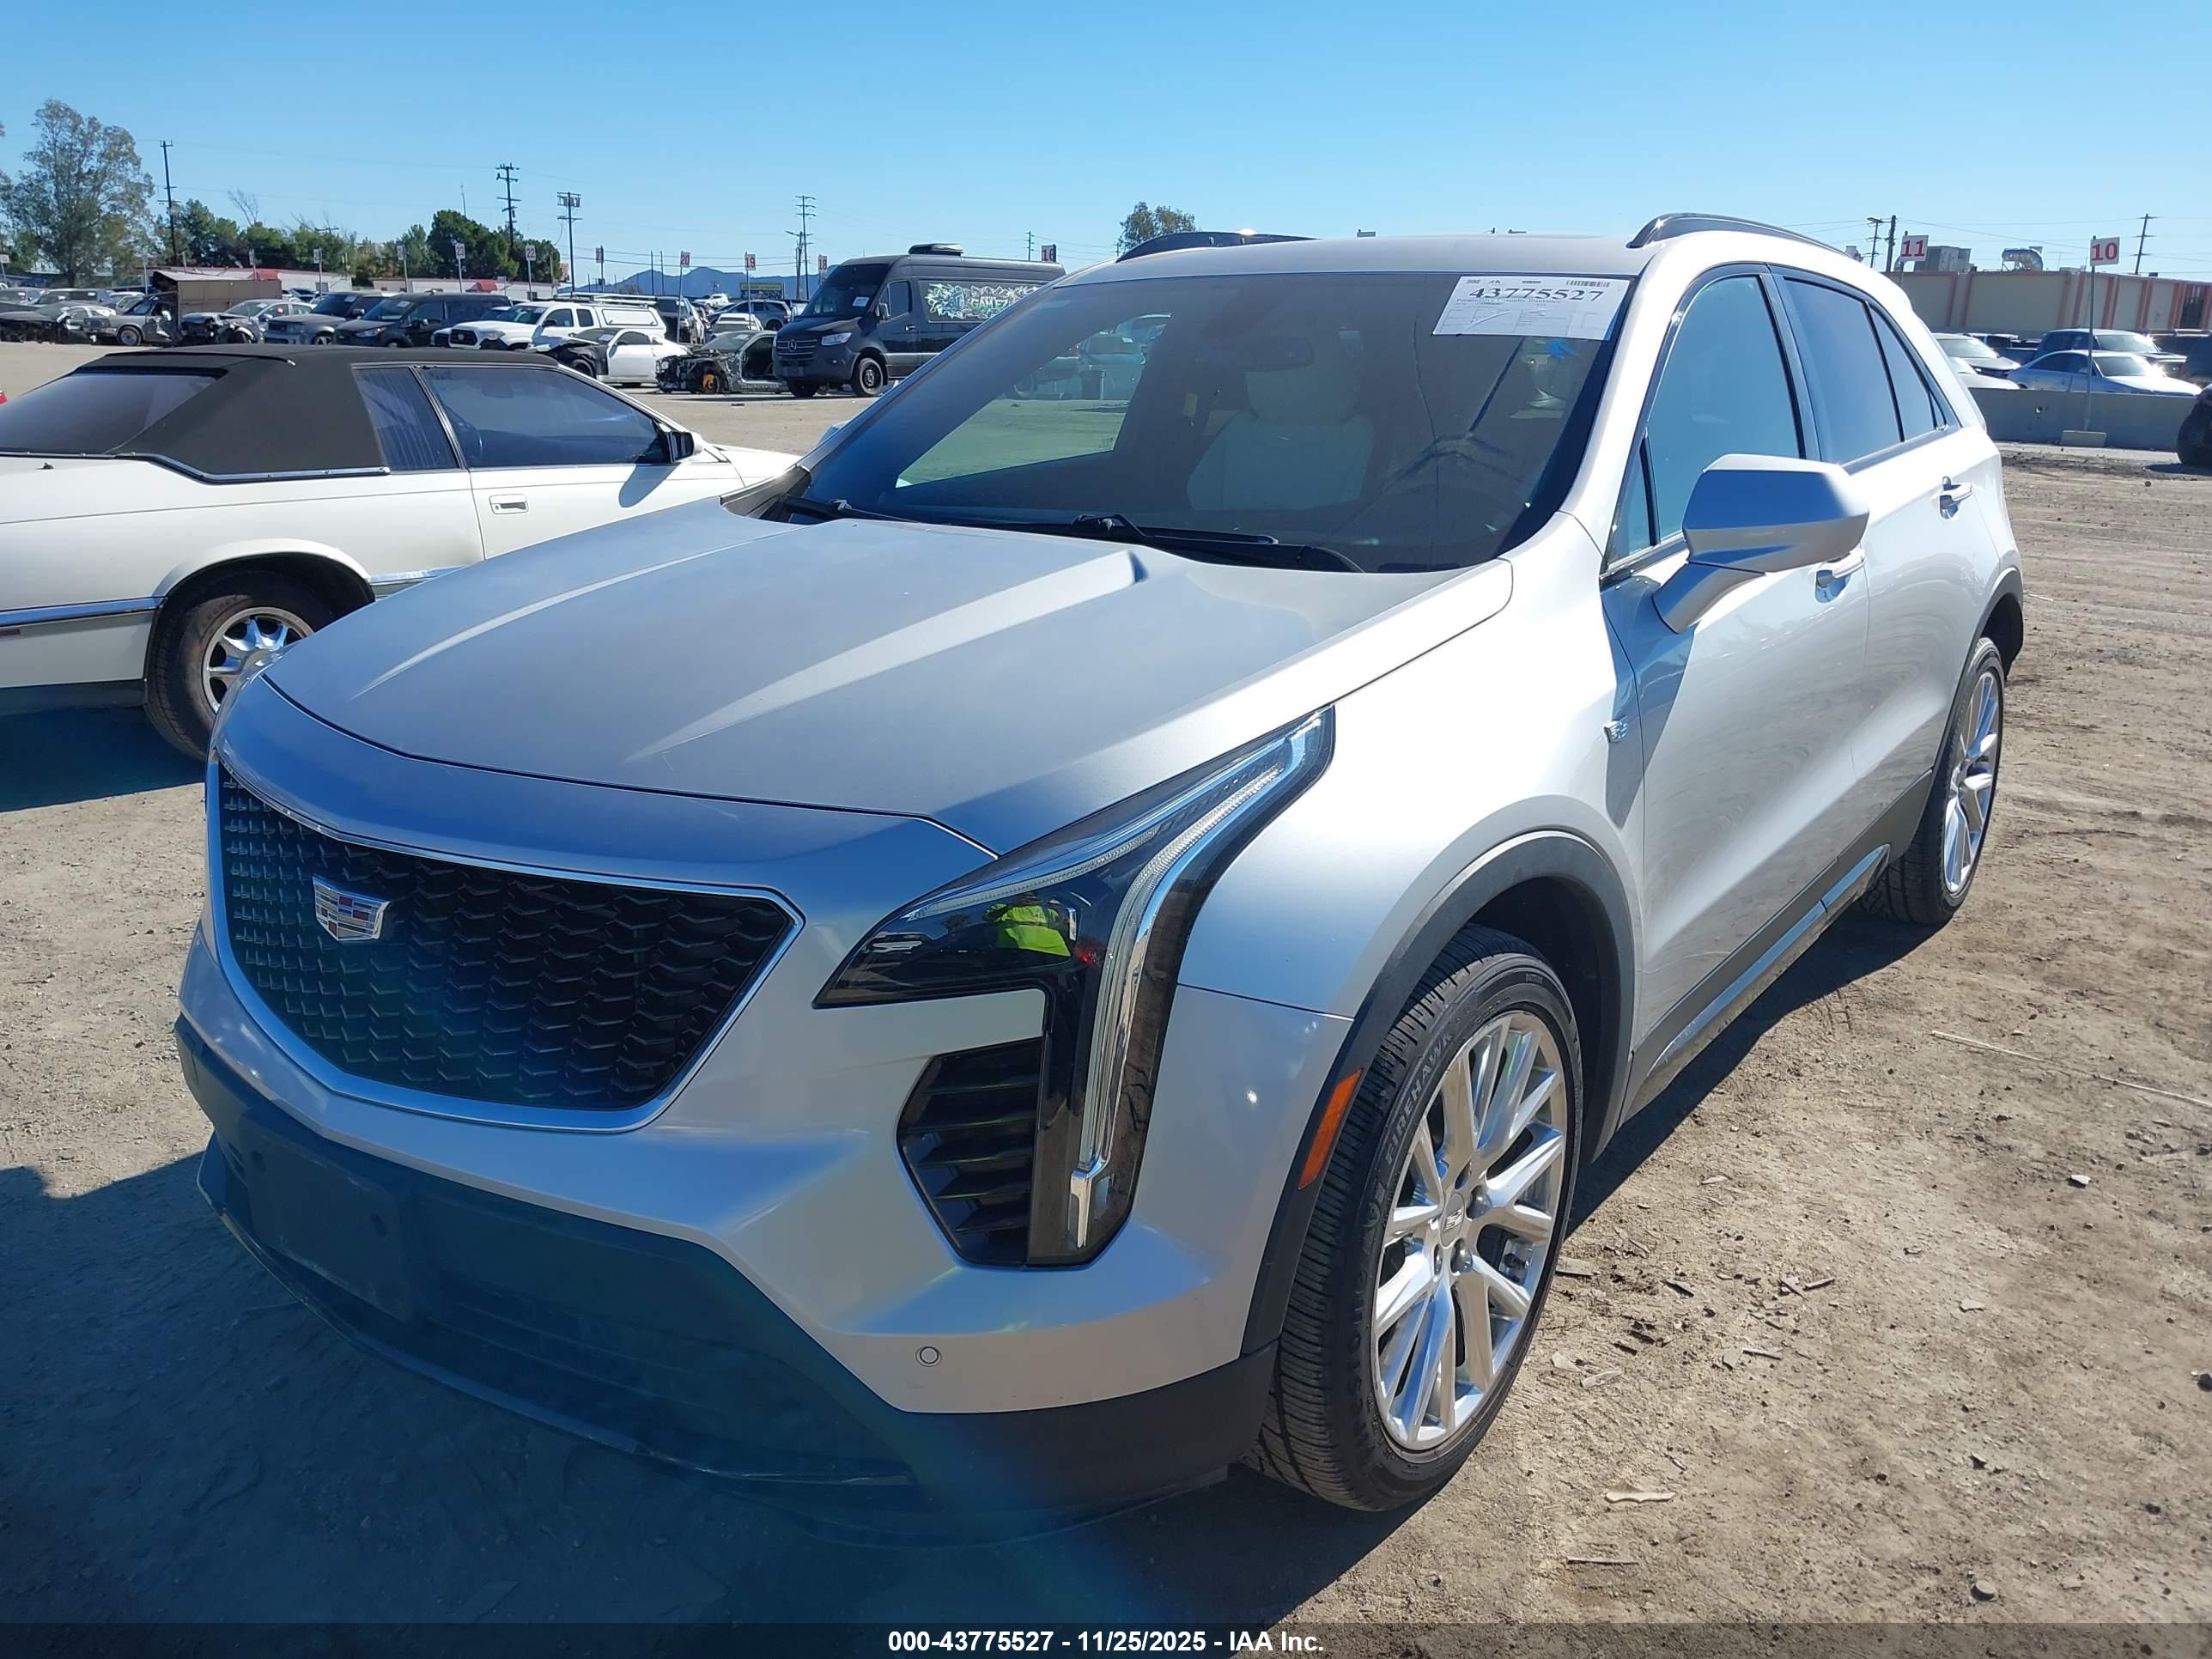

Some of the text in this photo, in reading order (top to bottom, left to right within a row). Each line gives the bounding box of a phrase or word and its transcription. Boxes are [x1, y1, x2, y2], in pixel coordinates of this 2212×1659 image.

[526, 247, 535, 258] 22
[1901, 240, 1924, 257] 11
[2092, 243, 2118, 260] 10
[680, 255, 690, 265] 20
[745, 258, 756, 268] 19
[818, 258, 827, 270] 18
[1468, 288, 1604, 301] 43775527
[1385, 1030, 1454, 1165] FIREHAWK
